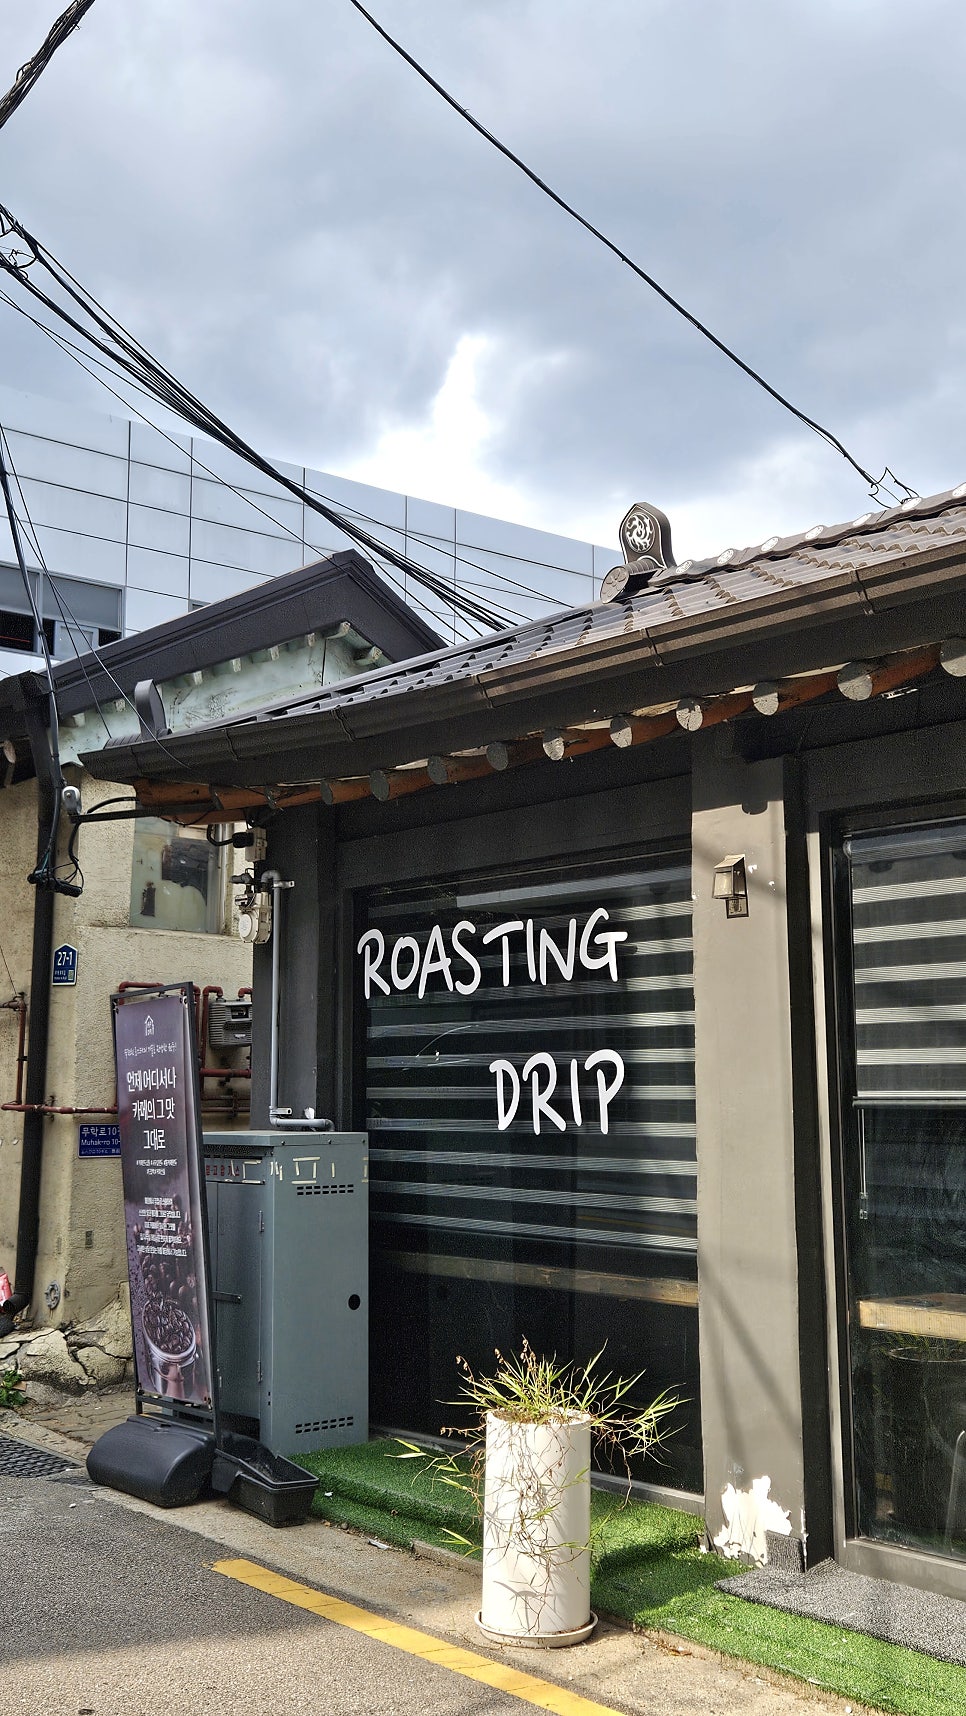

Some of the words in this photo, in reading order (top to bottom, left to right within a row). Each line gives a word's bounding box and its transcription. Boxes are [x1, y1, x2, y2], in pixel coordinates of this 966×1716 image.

[57, 951, 73, 966] 27-1
[357, 907, 628, 999] ROASTING
[489, 1048, 625, 1136] DRIP
[143, 1128, 166, 1150] 그대로
